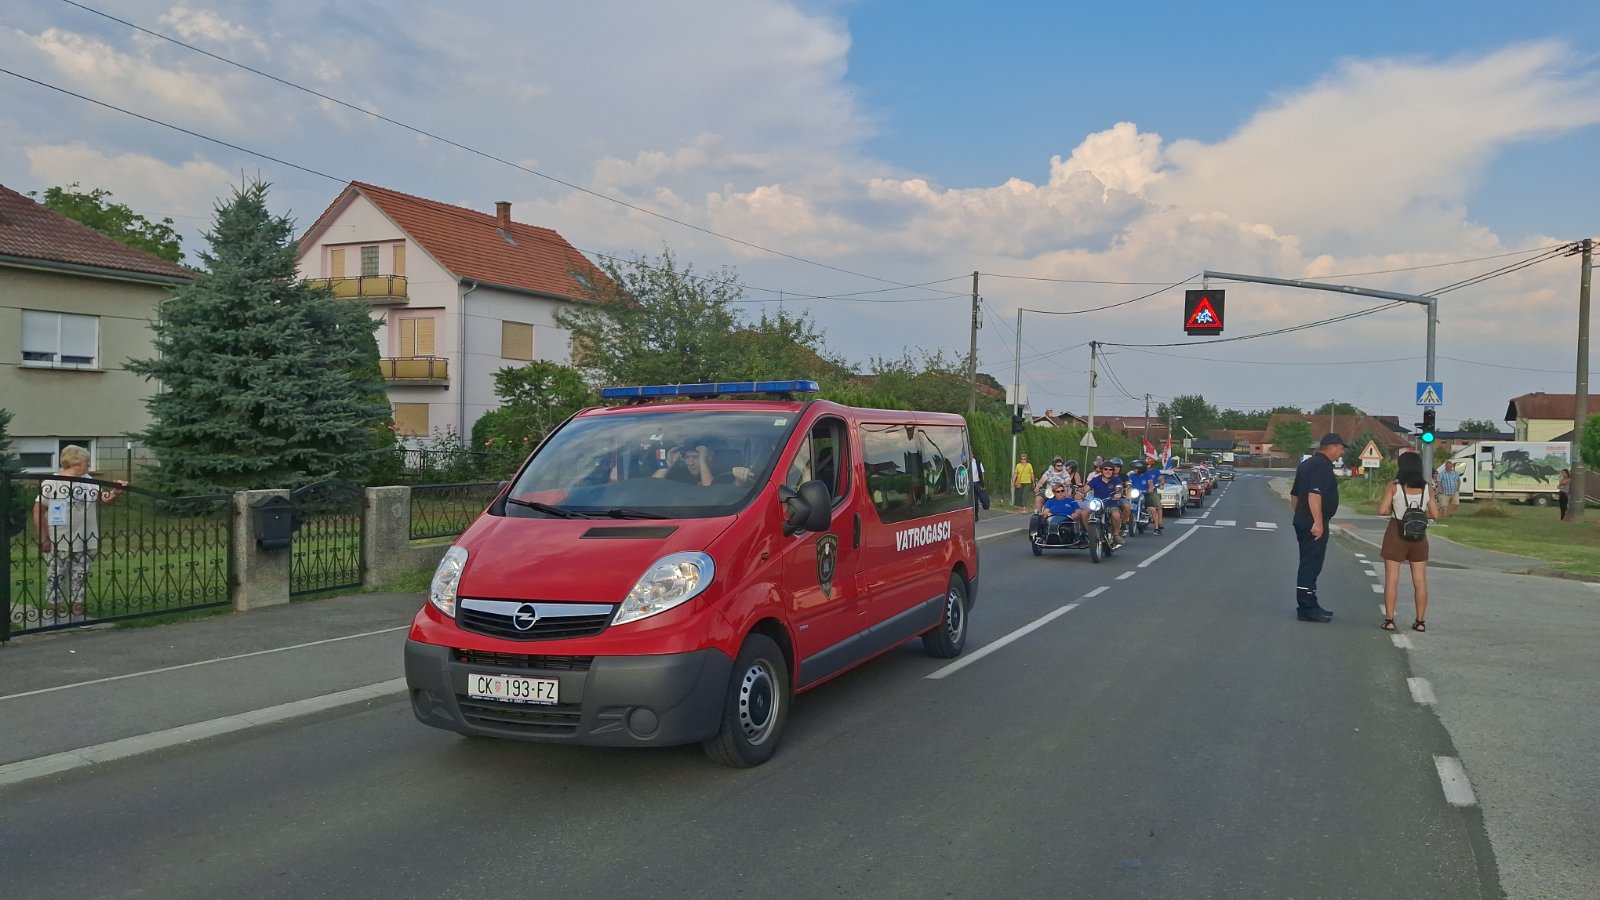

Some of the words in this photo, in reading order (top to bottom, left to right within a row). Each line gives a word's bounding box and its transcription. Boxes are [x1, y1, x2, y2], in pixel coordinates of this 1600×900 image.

[896, 521, 951, 552] VATROGASCI
[478, 677, 493, 695] CK
[505, 679, 555, 699] 193-FZ
